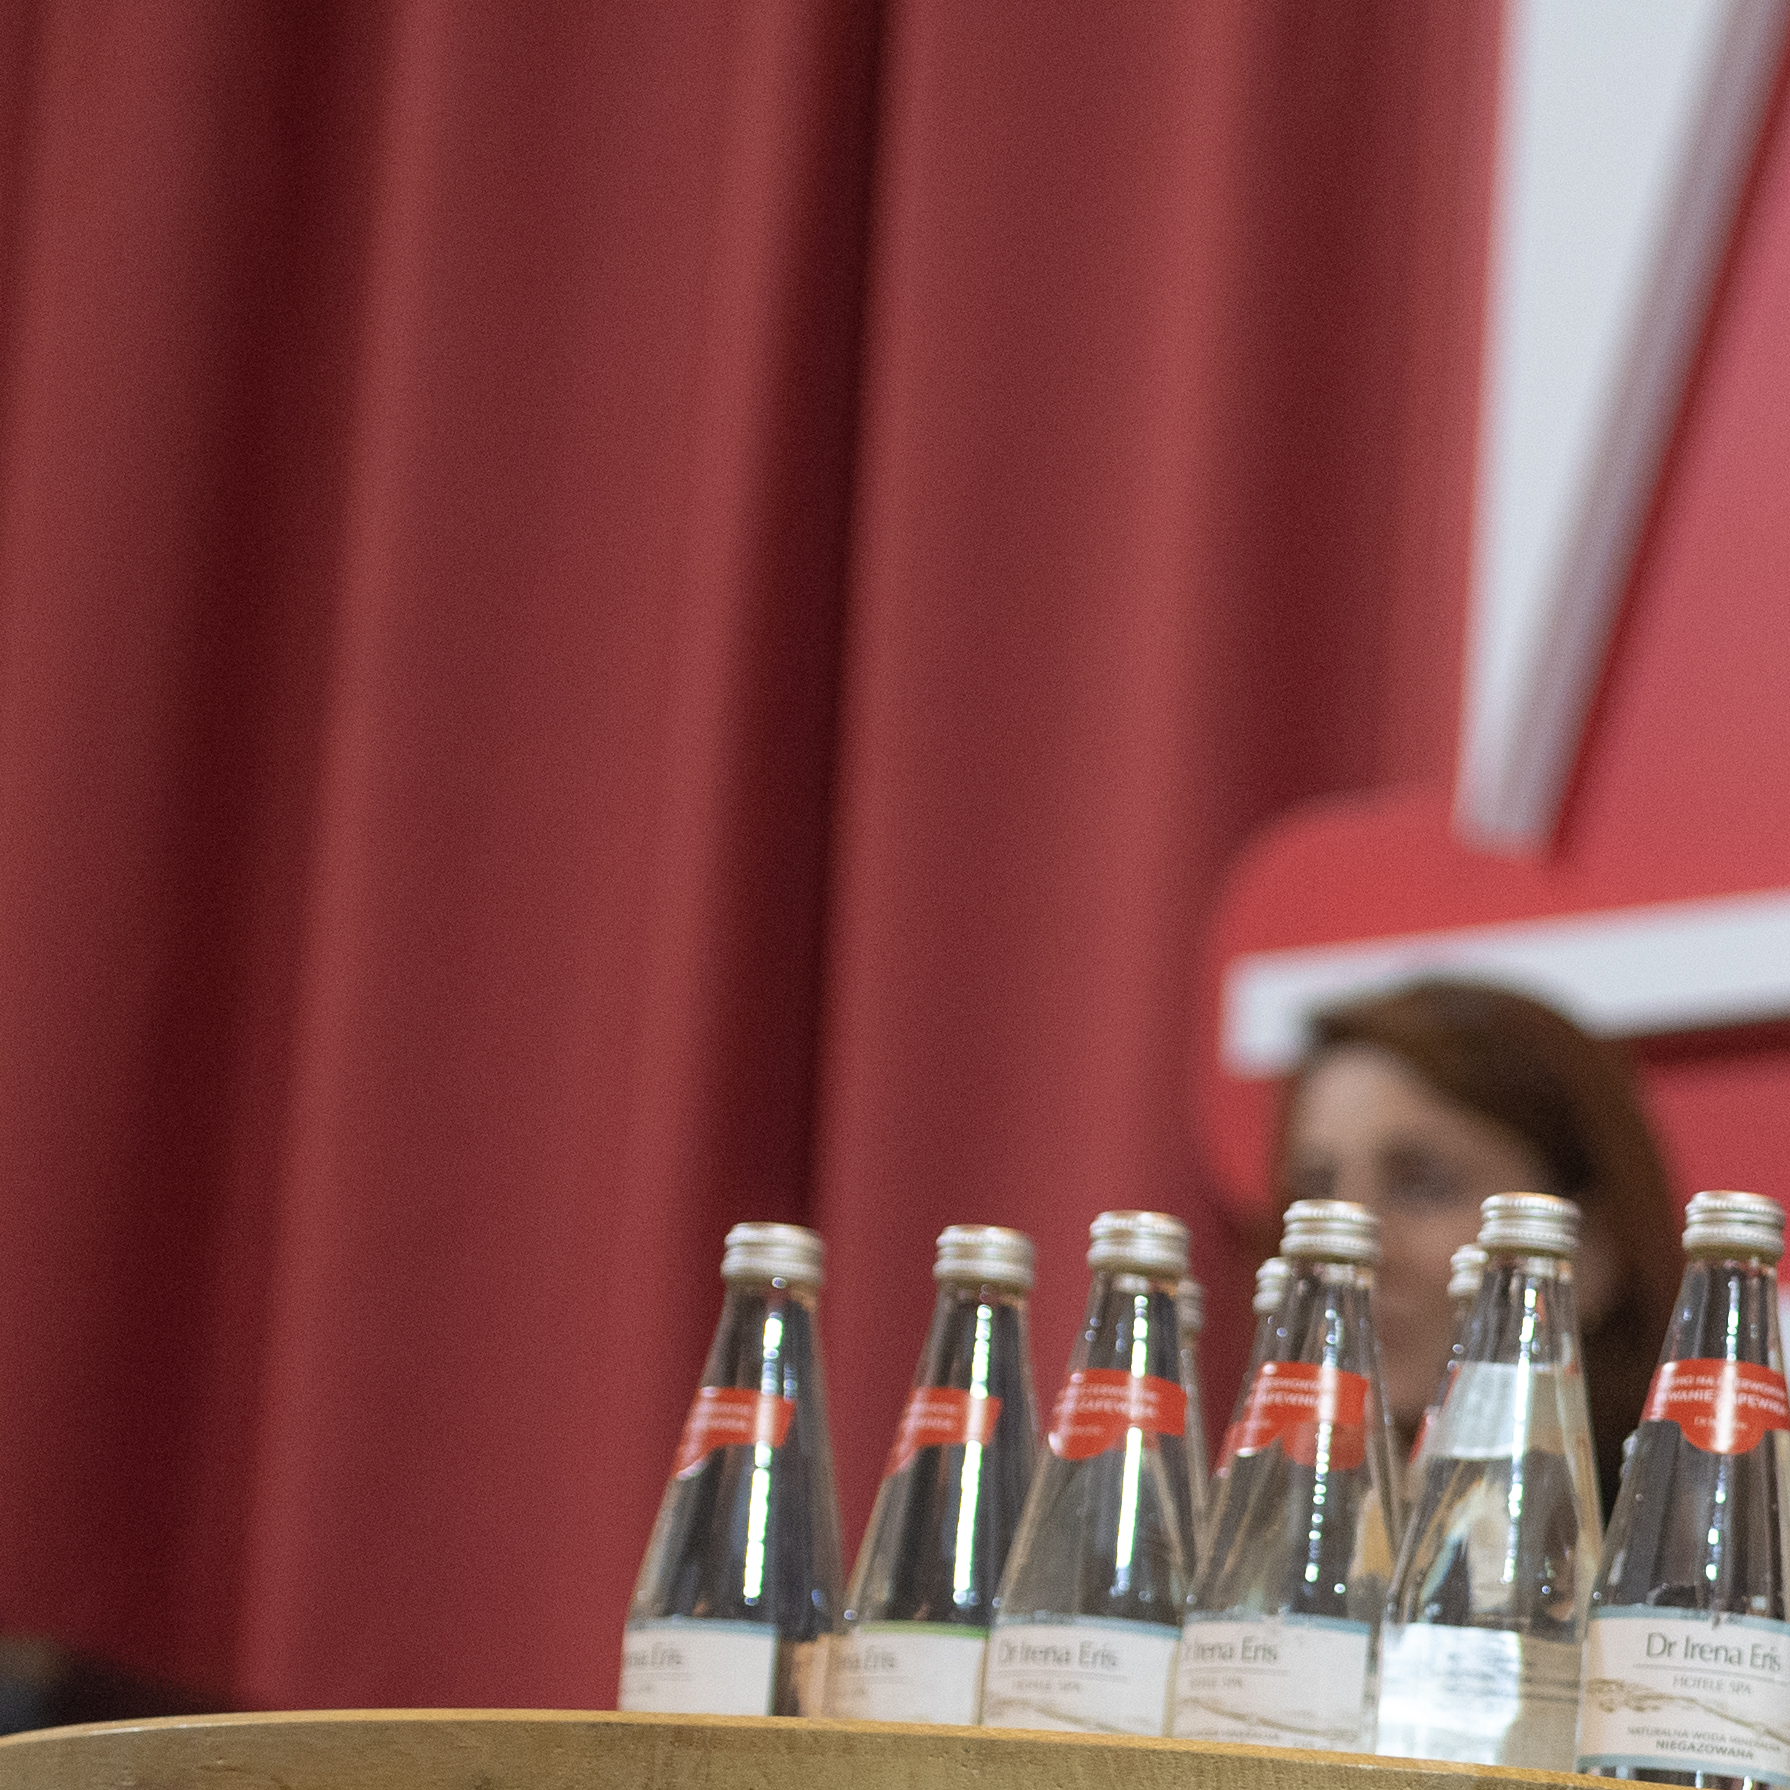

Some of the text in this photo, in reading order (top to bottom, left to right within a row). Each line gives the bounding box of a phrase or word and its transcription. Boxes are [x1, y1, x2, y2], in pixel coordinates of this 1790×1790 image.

[1645, 1632, 1781, 1672] Dr Irena Eris
[1672, 1675, 1752, 1695] HOTELE SPA
[1656, 1739, 1754, 1760] NIEGAZOWANA
